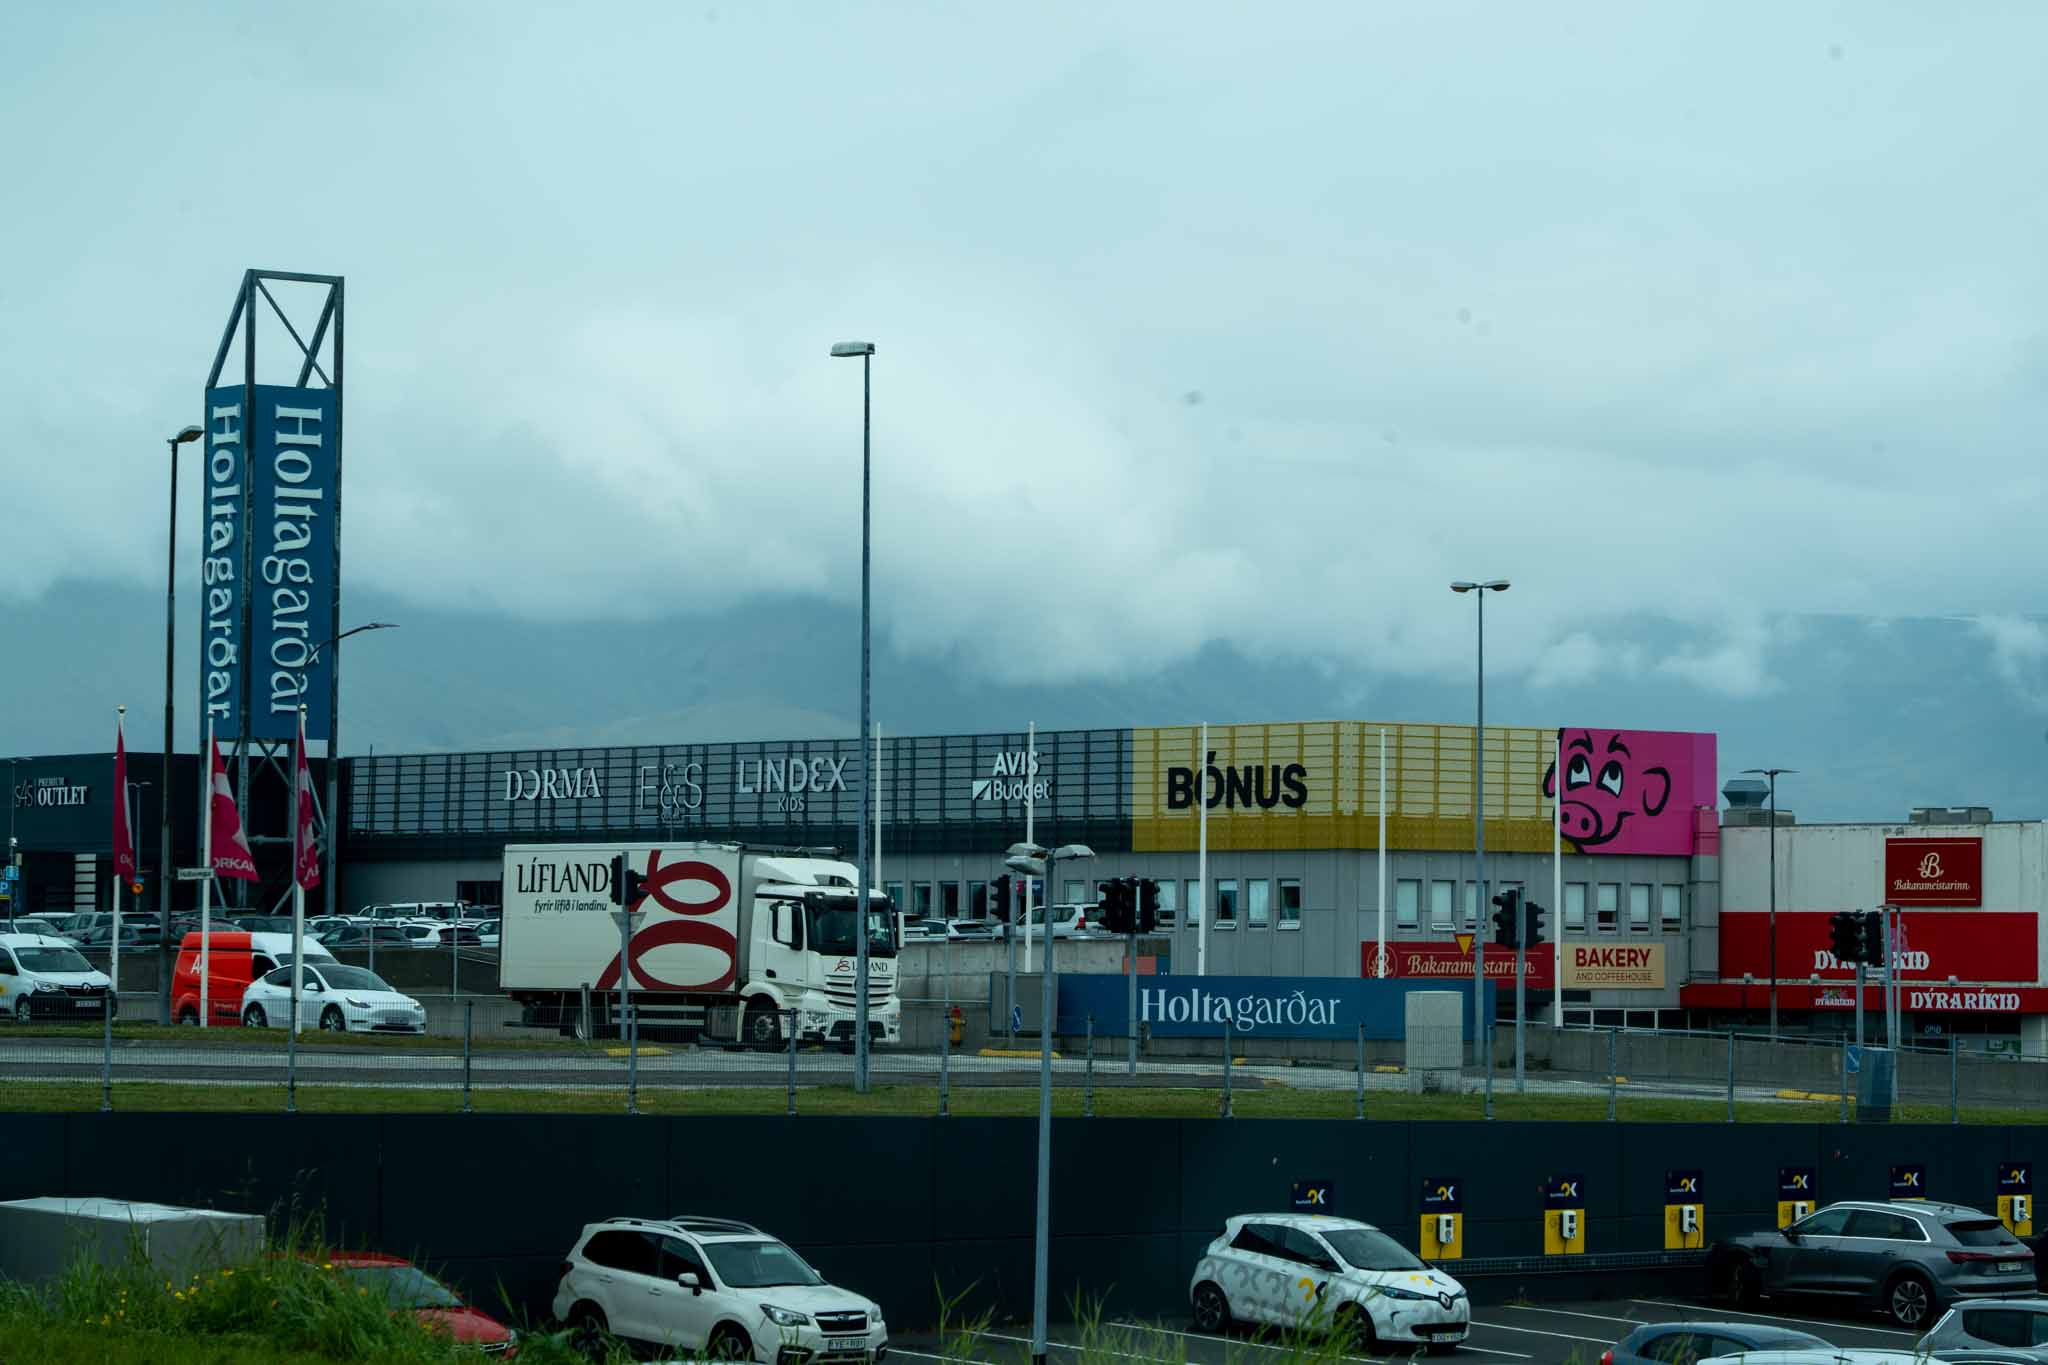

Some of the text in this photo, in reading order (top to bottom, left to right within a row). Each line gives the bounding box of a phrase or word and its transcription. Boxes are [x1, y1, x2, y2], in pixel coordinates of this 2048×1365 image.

[204, 403, 241, 719] Holtagarðar
[262, 404, 324, 719] Holtagarðar
[739, 757, 848, 793] LINDEX
[992, 751, 1039, 776] AVIS
[994, 780, 1049, 807] Budget
[1168, 751, 1308, 809] BÓNUS
[38, 785, 87, 805] OUTLET
[778, 796, 805, 812] KIDS
[517, 857, 609, 893] LÍFLAND
[534, 900, 555, 913] fyrir
[576, 900, 608, 912] landinu
[1576, 948, 1652, 967] BAKERY
[1576, 972, 1653, 981] AND COFFEEHOUSE
[1141, 988, 1341, 1032] Holtagarðar
